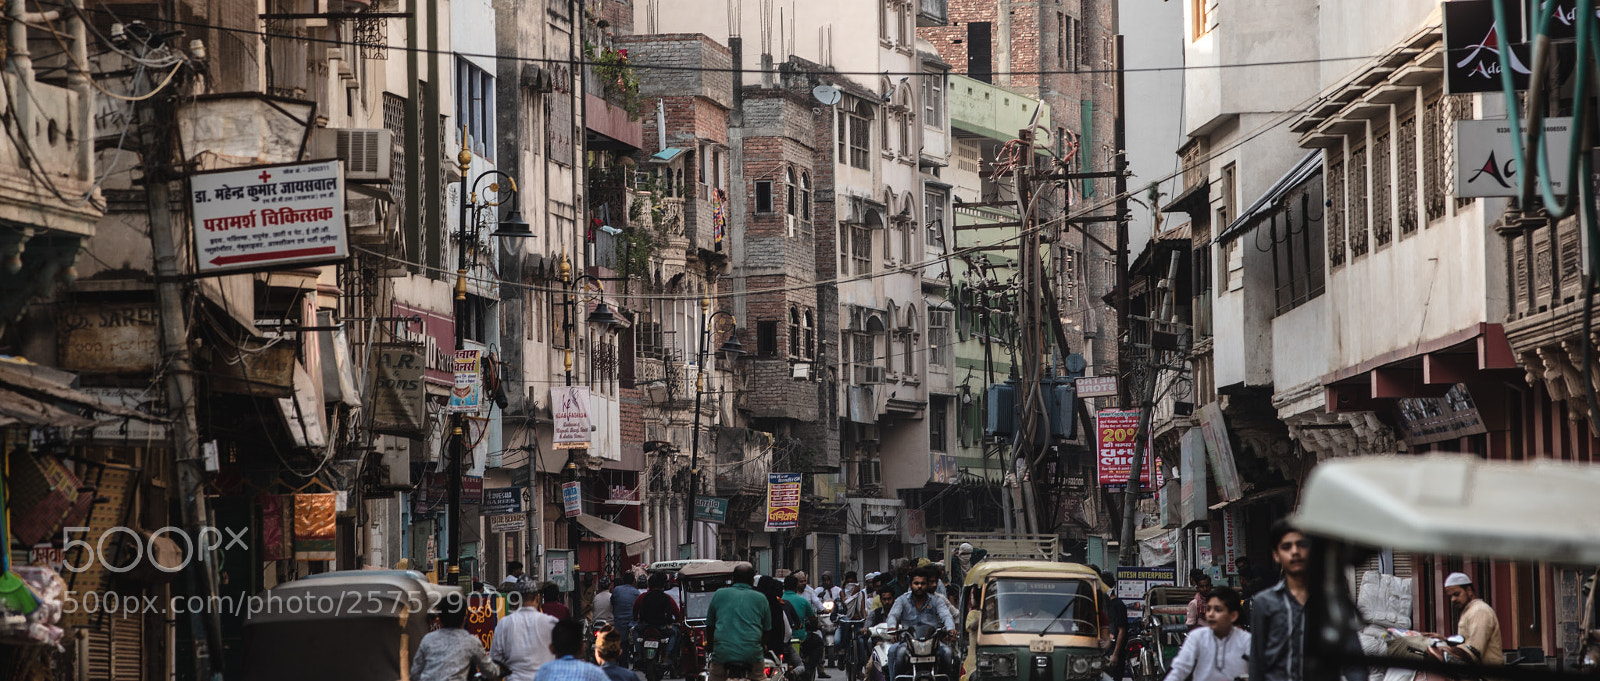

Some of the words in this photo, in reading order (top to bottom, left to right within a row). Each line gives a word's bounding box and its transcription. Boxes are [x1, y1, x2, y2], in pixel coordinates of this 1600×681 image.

[194, 190, 212, 203] डा.
[214, 184, 244, 201] महेन्द्र
[247, 183, 277, 203] कुमार
[280, 177, 338, 194] जायसवाल
[203, 209, 257, 232] परामर्श
[261, 206, 334, 227] चिकित्सक
[1117, 571, 1137, 579] NITESH
[1137, 571, 1174, 579] ENTERPRISES
